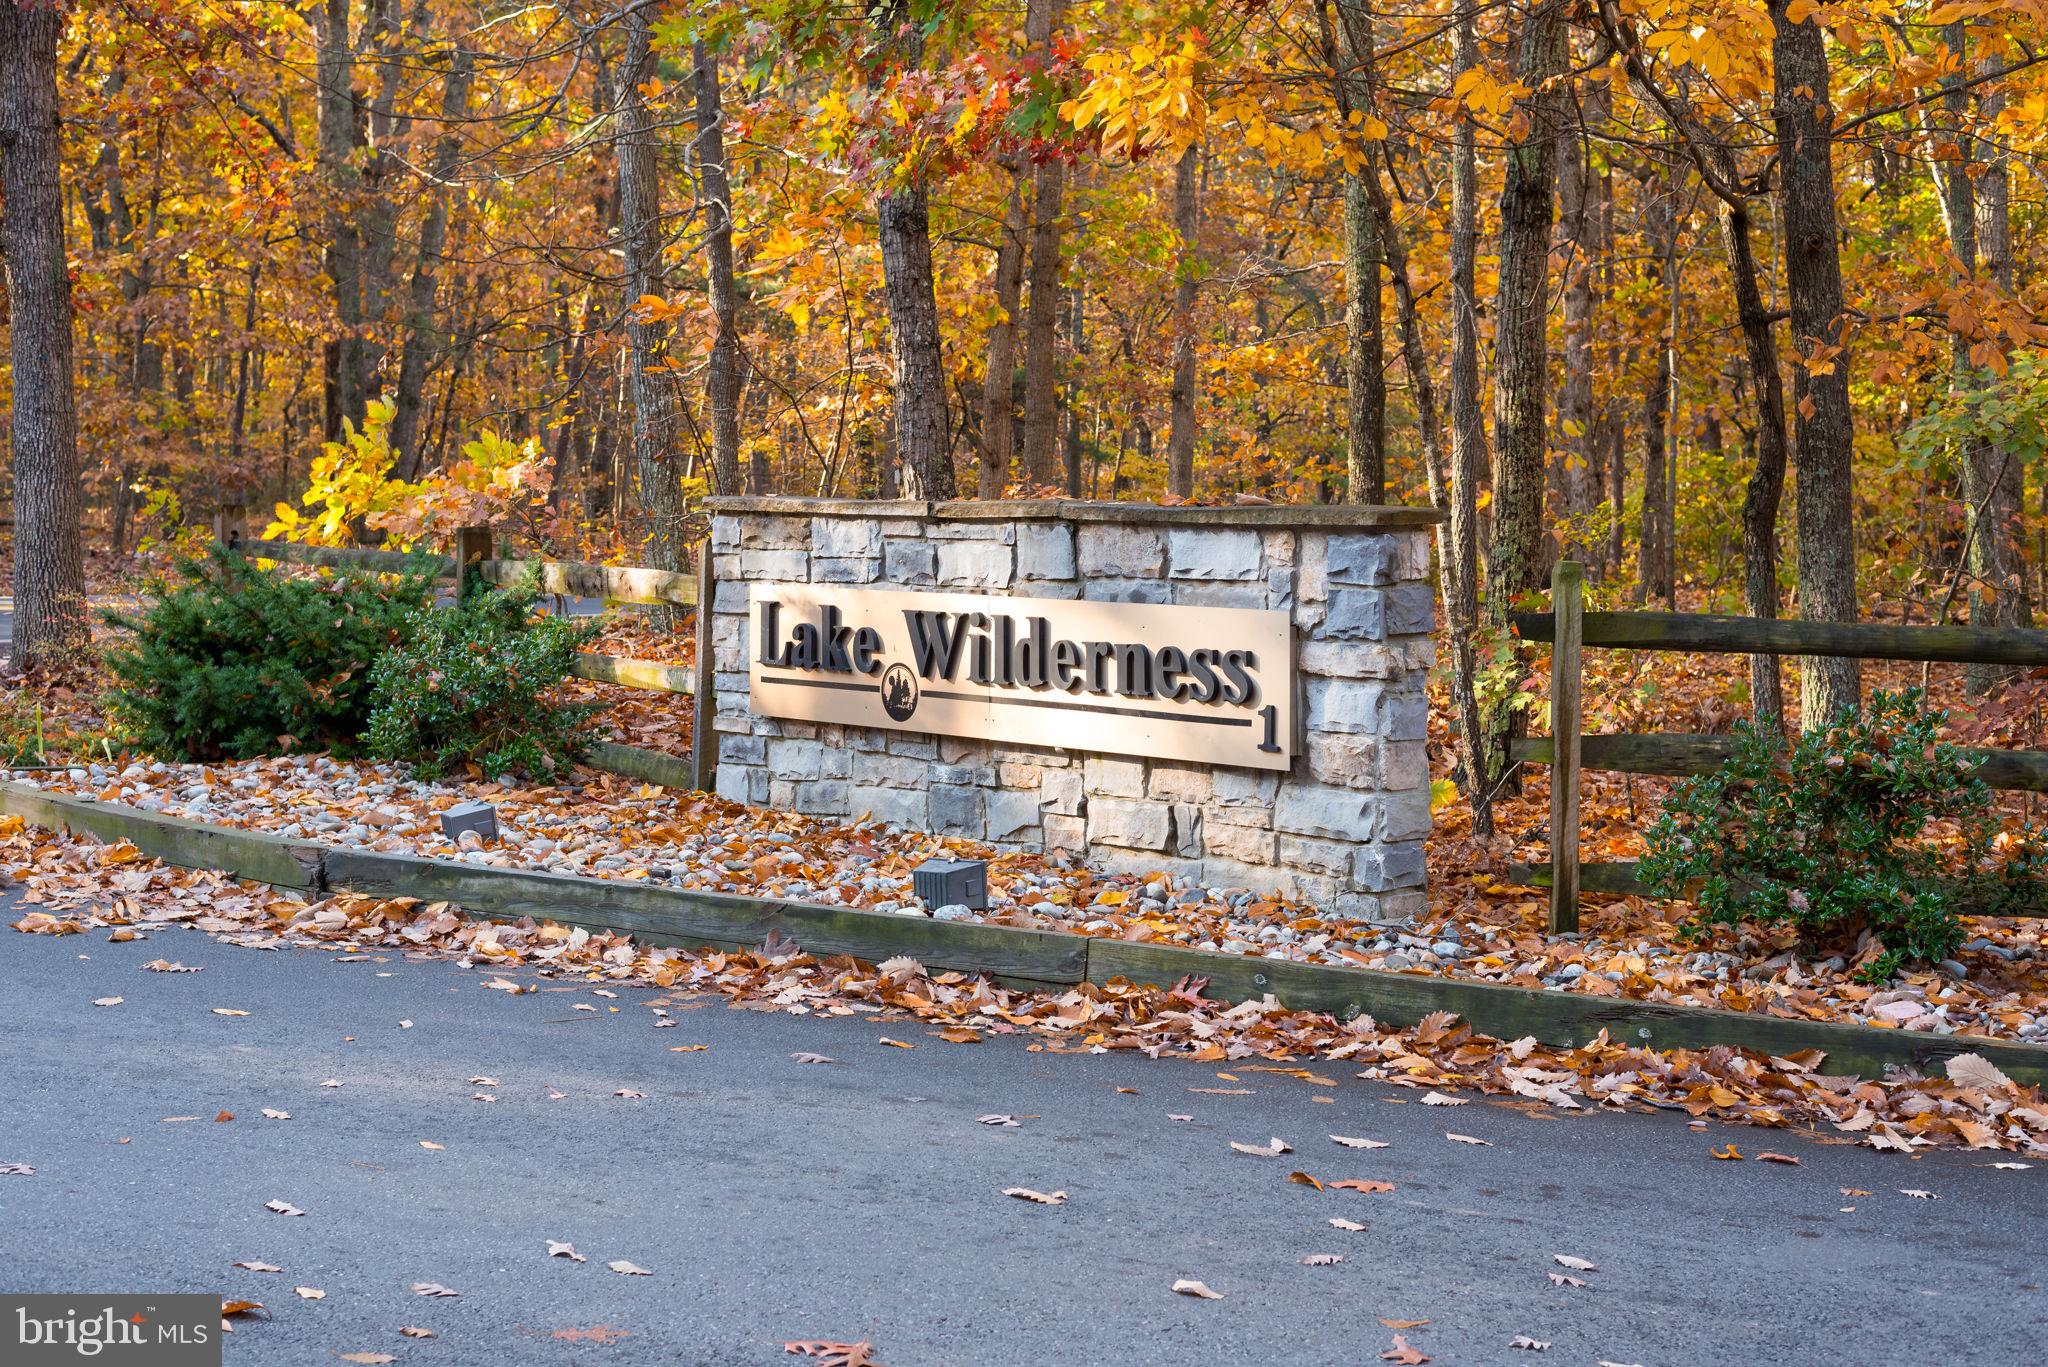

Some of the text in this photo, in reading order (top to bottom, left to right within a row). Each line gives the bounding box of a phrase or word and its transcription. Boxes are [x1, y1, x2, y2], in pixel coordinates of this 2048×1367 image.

[756, 600, 1259, 708] Lake Wilderness
[1257, 704, 1281, 753] 1
